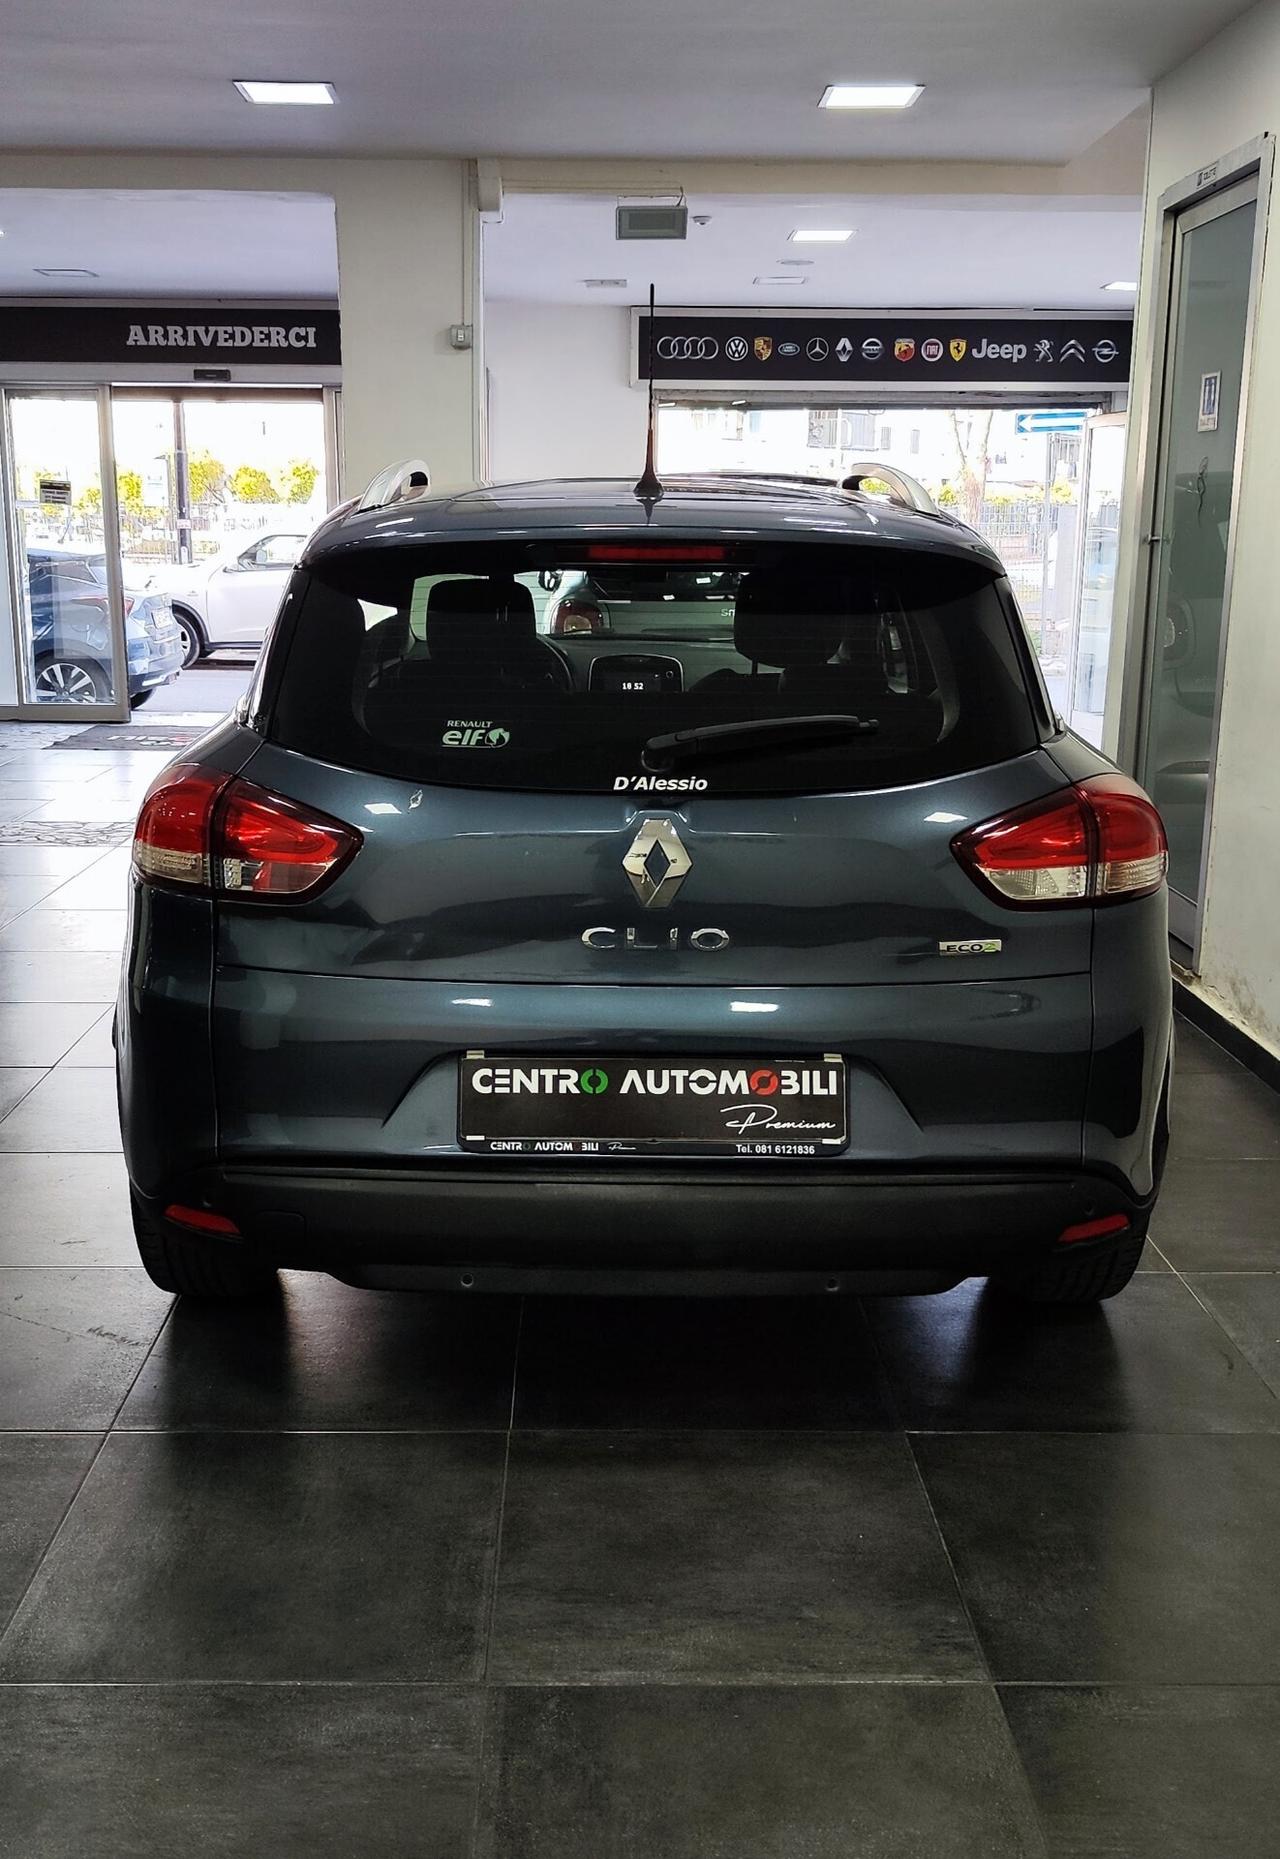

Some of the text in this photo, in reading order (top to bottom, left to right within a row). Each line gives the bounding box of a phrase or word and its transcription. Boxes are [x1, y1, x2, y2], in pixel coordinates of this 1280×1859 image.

[126, 325, 317, 348] ARRIVEDERCI
[971, 338, 1027, 363] Jeep
[447, 720, 493, 728] RENAULT
[442, 729, 486, 745] elf
[613, 776, 708, 791] D'Alessio
[581, 926, 730, 951] CLIO
[946, 942, 997, 953] ECO2
[471, 1068, 837, 1096] CENTRO AUTOMOBILI
[720, 1103, 836, 1135] Premium
[736, 1144, 815, 1154] Tel. 081 6121836
